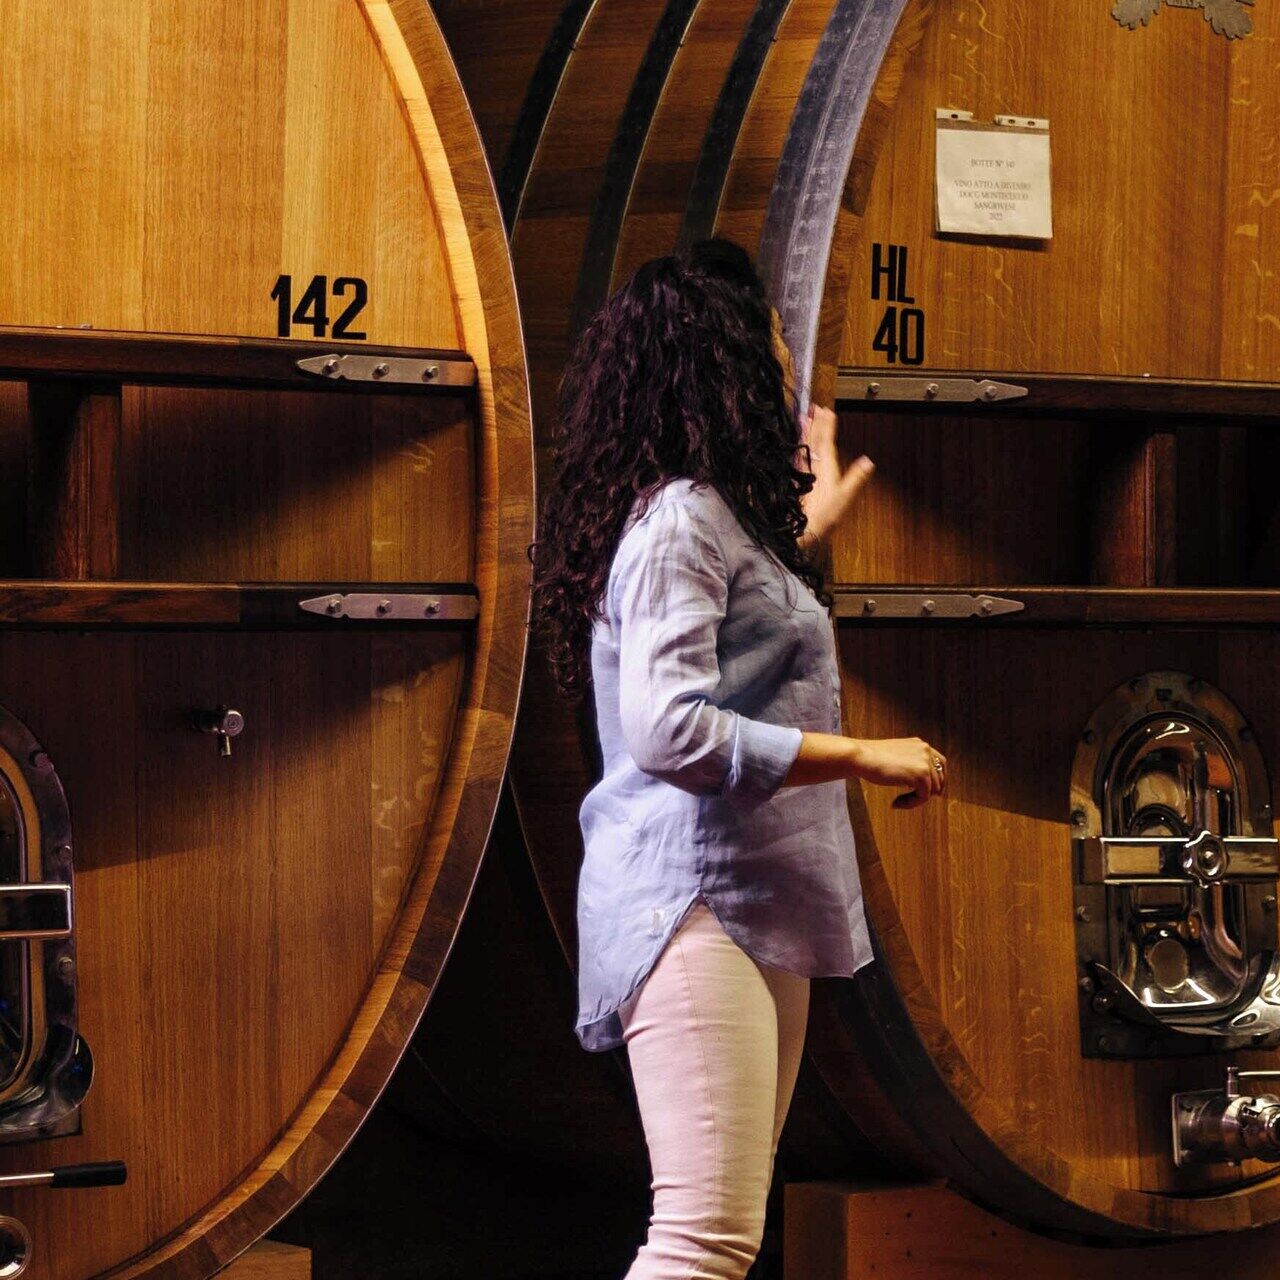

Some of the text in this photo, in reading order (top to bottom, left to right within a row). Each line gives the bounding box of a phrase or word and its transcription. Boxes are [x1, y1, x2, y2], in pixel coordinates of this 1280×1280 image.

[954, 179, 973, 188] VINO
[974, 180, 993, 189] ATTO
[970, 159, 993, 168] BOTTE
[871, 243, 915, 304] HL
[271, 274, 368, 340] 142
[872, 306, 925, 366] 40
